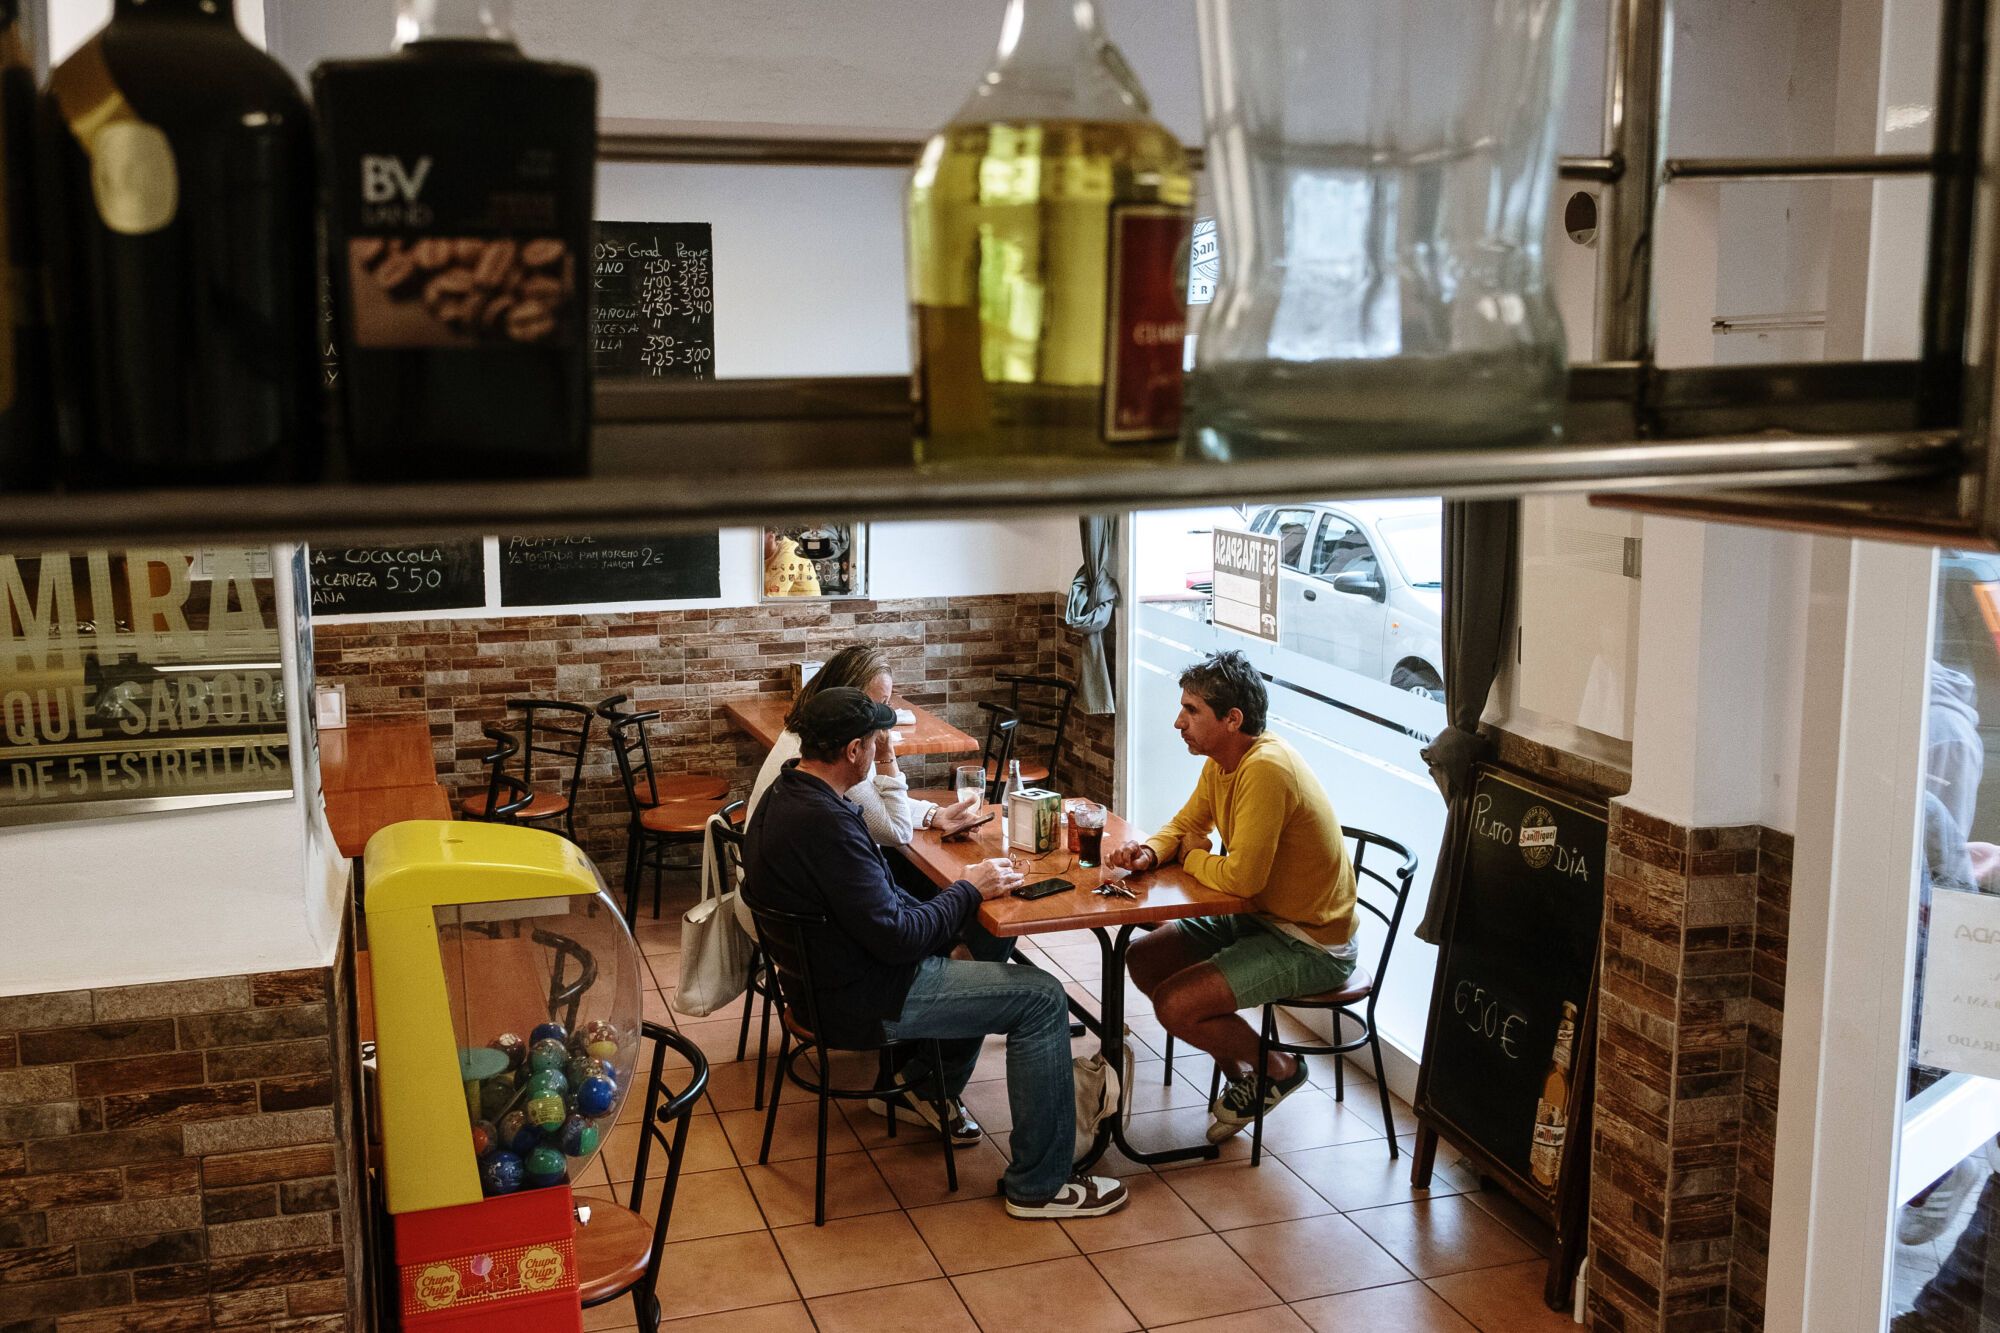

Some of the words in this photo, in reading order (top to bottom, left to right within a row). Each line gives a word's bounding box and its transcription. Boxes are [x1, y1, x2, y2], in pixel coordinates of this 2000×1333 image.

[361, 154, 432, 203] BV
[628, 236, 662, 258] Grad
[0, 551, 276, 671] MIRA
[3, 684, 104, 746] QUE
[117, 670, 278, 735] SABOR
[11, 759, 58, 800] DE
[67, 757, 89, 796] 5
[100, 744, 282, 793] ESTRELLAS
[1475, 793, 1513, 845] PLATO
[422, 1273, 455, 1286] Chupa
[524, 1266, 557, 1284] Chups
[526, 1257, 557, 1269] Chupa
[420, 1284, 454, 1301] Chups
